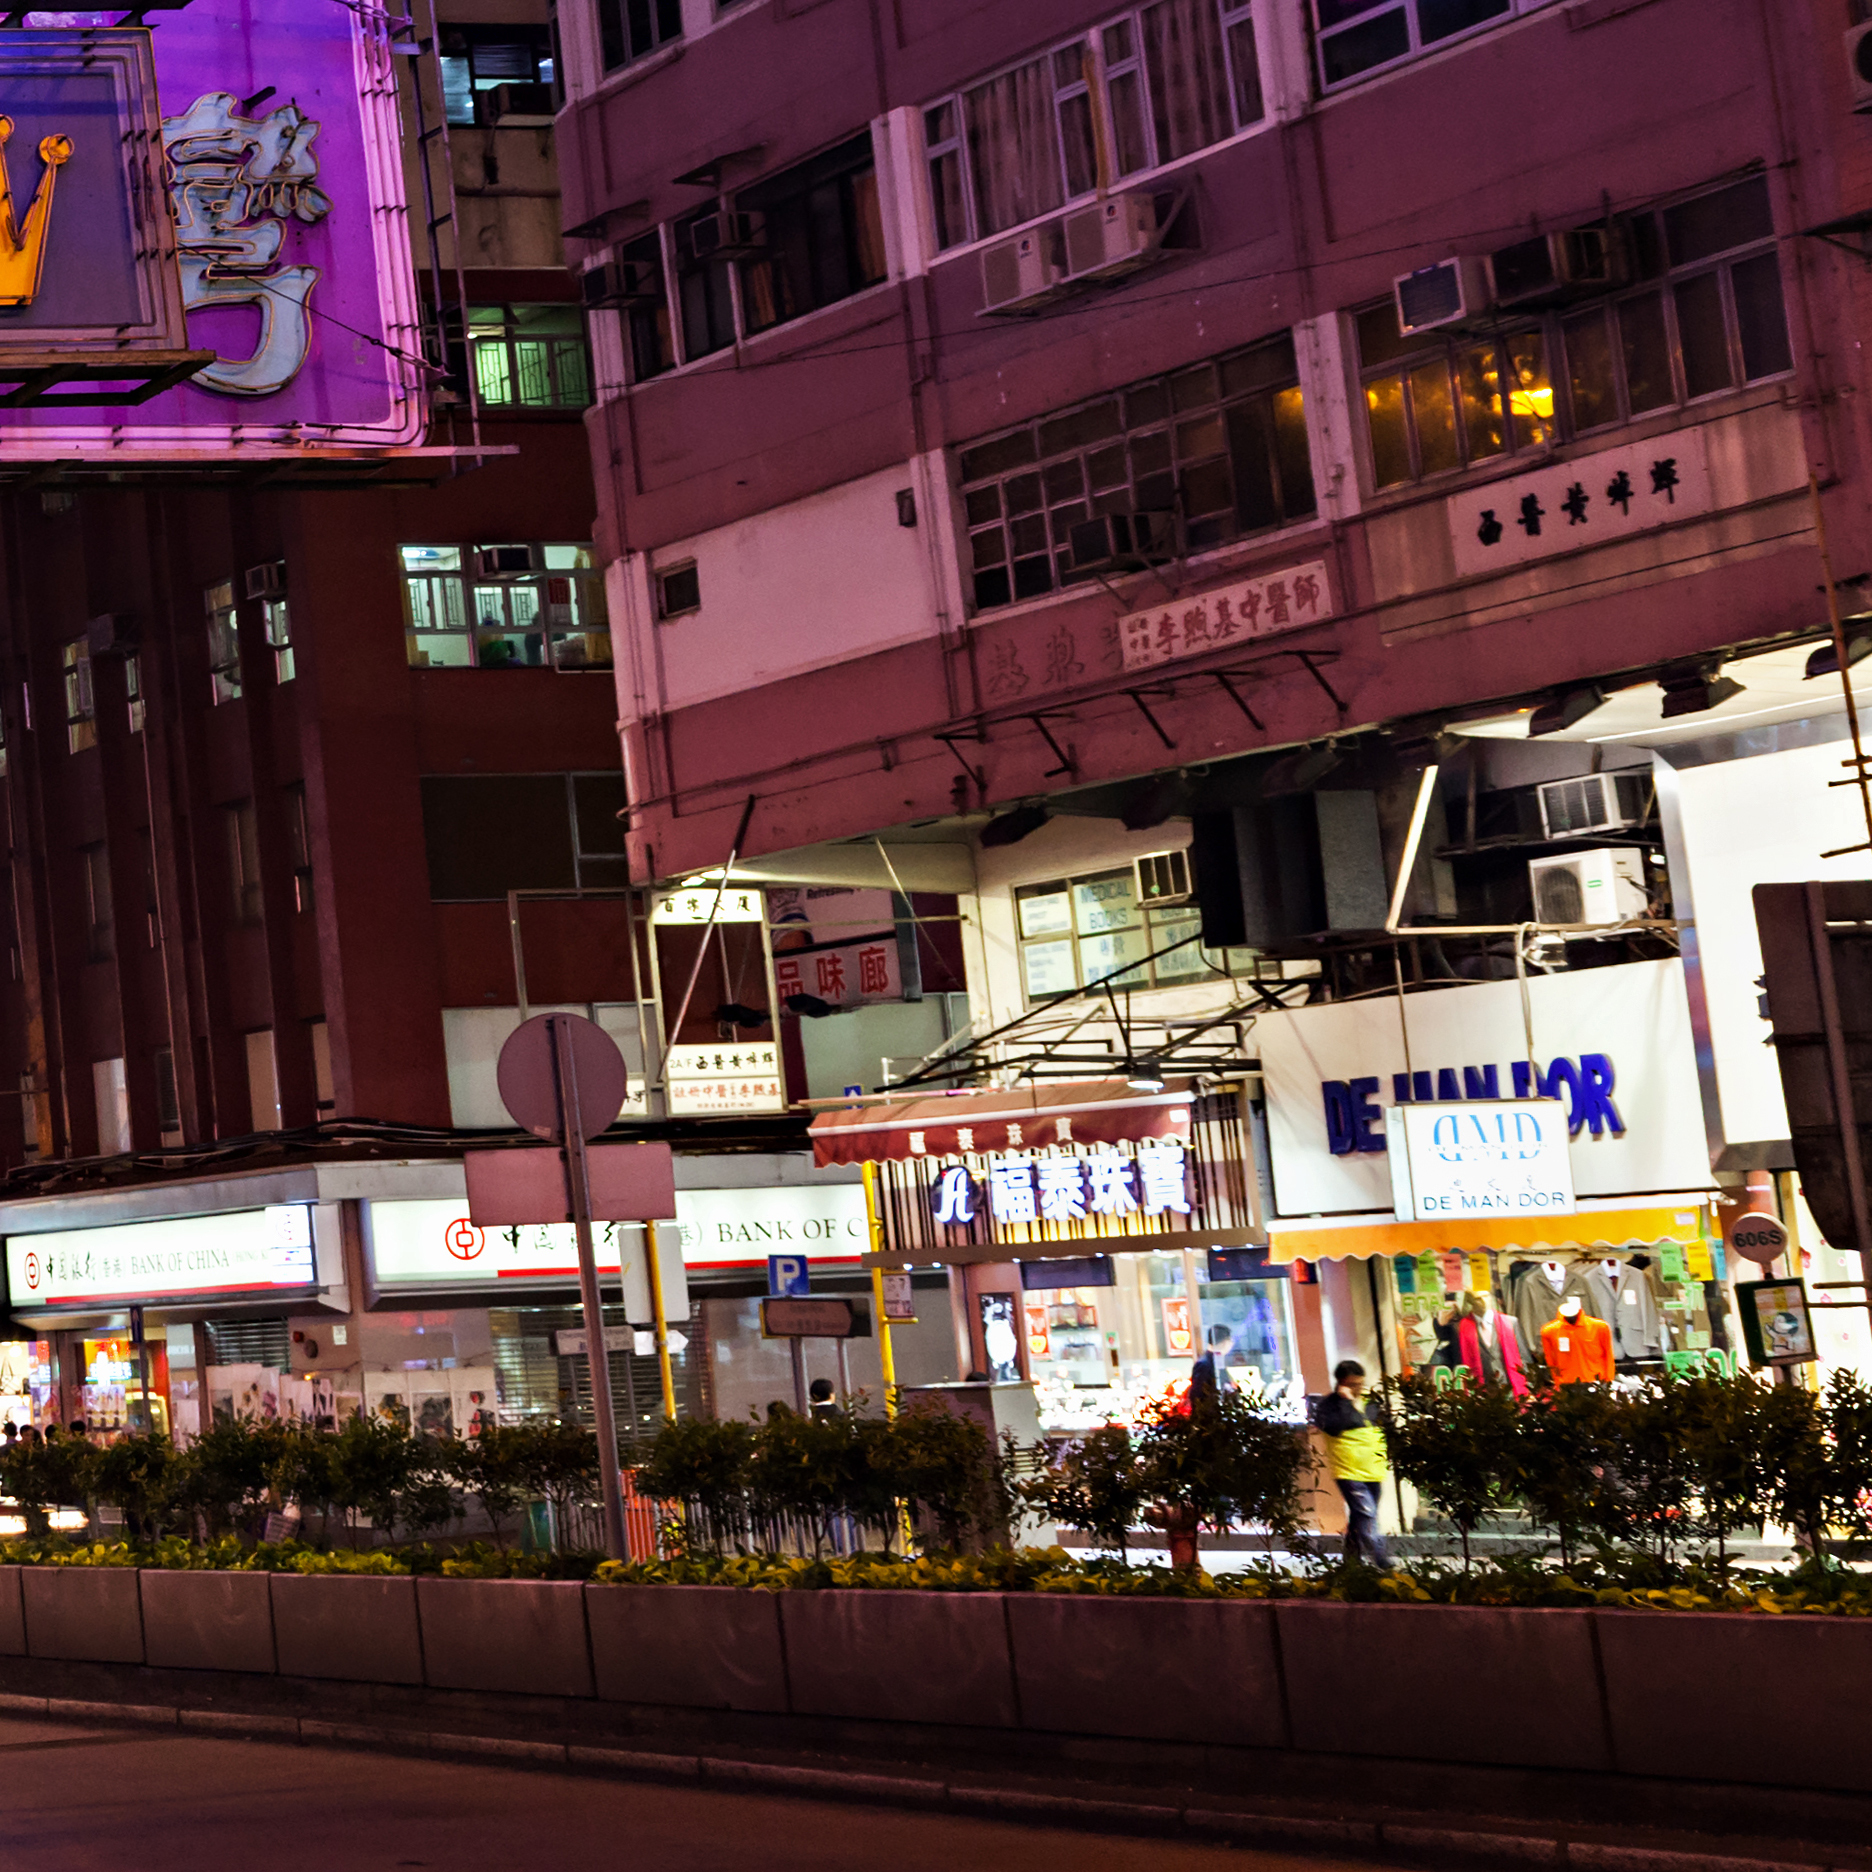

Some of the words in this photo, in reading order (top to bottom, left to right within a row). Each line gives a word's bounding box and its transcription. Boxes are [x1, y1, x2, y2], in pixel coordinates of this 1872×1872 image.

[1089, 908, 1128, 929] BOOKS
[1322, 1076, 1388, 1155] DE
[990, 1145, 1191, 1225] 福泰珠寶
[1424, 1196, 1452, 1211] DE
[1462, 1193, 1510, 1209] MAN
[1519, 1190, 1567, 1207] DOR
[718, 1222, 793, 1243] BANK
[803, 1218, 837, 1240] OF
[1734, 1231, 1784, 1248] 606S
[131, 1254, 164, 1275] BANK
[168, 1252, 184, 1272] OF
[186, 1248, 230, 1270] CHINA
[775, 1259, 802, 1291] P
